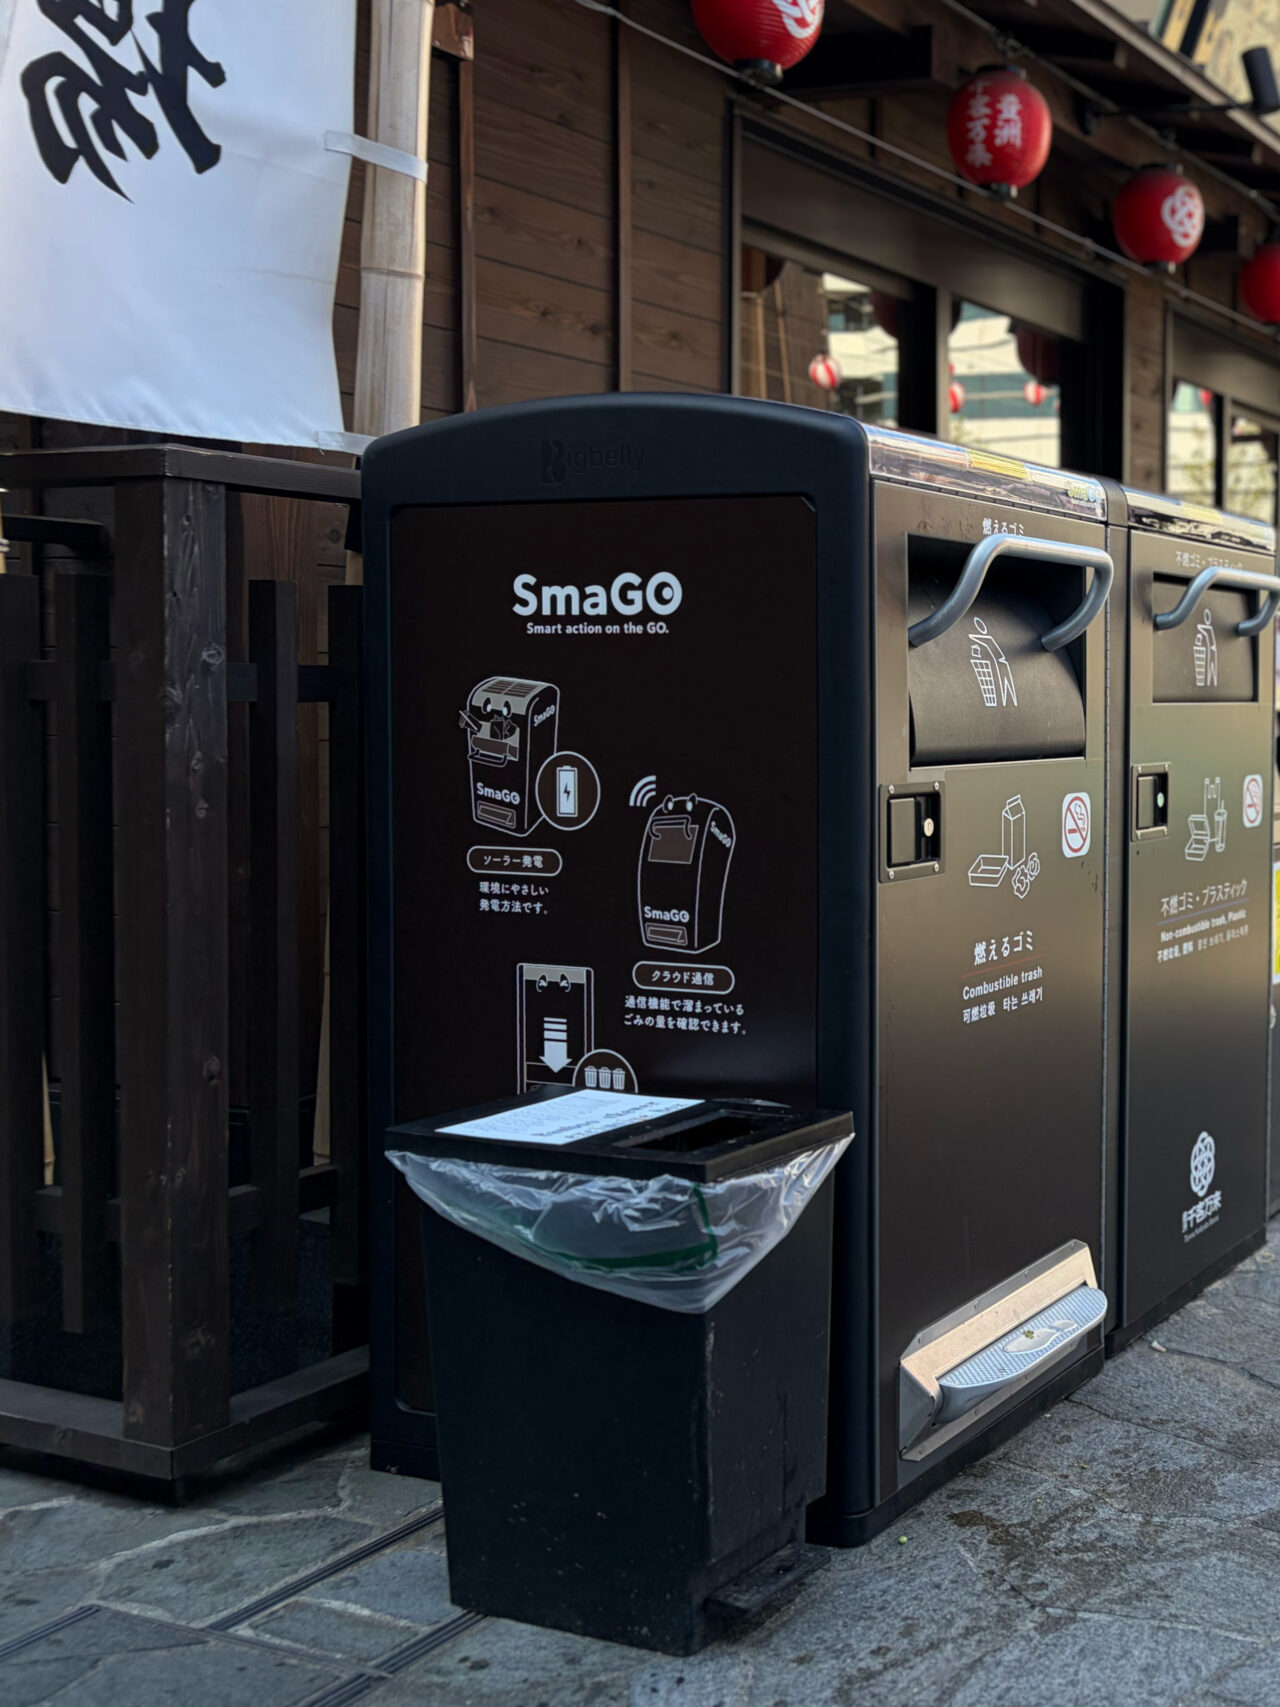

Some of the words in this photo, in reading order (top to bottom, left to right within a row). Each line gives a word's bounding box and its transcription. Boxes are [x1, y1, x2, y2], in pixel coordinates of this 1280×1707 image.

[540, 439, 646, 484] Bigbelly
[512, 571, 683, 616] SmaGO
[526, 622, 562, 634] Smart
[565, 622, 602, 634] action
[605, 624, 620, 634] on
[623, 622, 643, 634] the
[646, 622, 669, 634] GO.
[533, 704, 556, 727] SmaGO
[476, 782, 521, 805] SmaGO
[710, 821, 732, 848] SmaGO
[483, 855, 544, 868] ソーラー発電
[479, 881, 549, 896] 環境にやさしい
[1160, 878, 1248, 917] 不燃ゴミ・プラスティック
[479, 898, 549, 915] 発電方法です。
[643, 905, 690, 923] SmaGO
[974, 930, 1033, 966] 燃えるゴミ
[651, 970, 715, 986] クラウド通信
[962, 974, 1018, 1000] Combustible
[1021, 966, 1043, 983] trash
[624, 995, 744, 1016] 通信機能で溜まっている
[1003, 996, 1018, 1012] 타는
[1021, 986, 1043, 1006] 쓰레기
[624, 1013, 746, 1035] ごみの量を確認できます。
